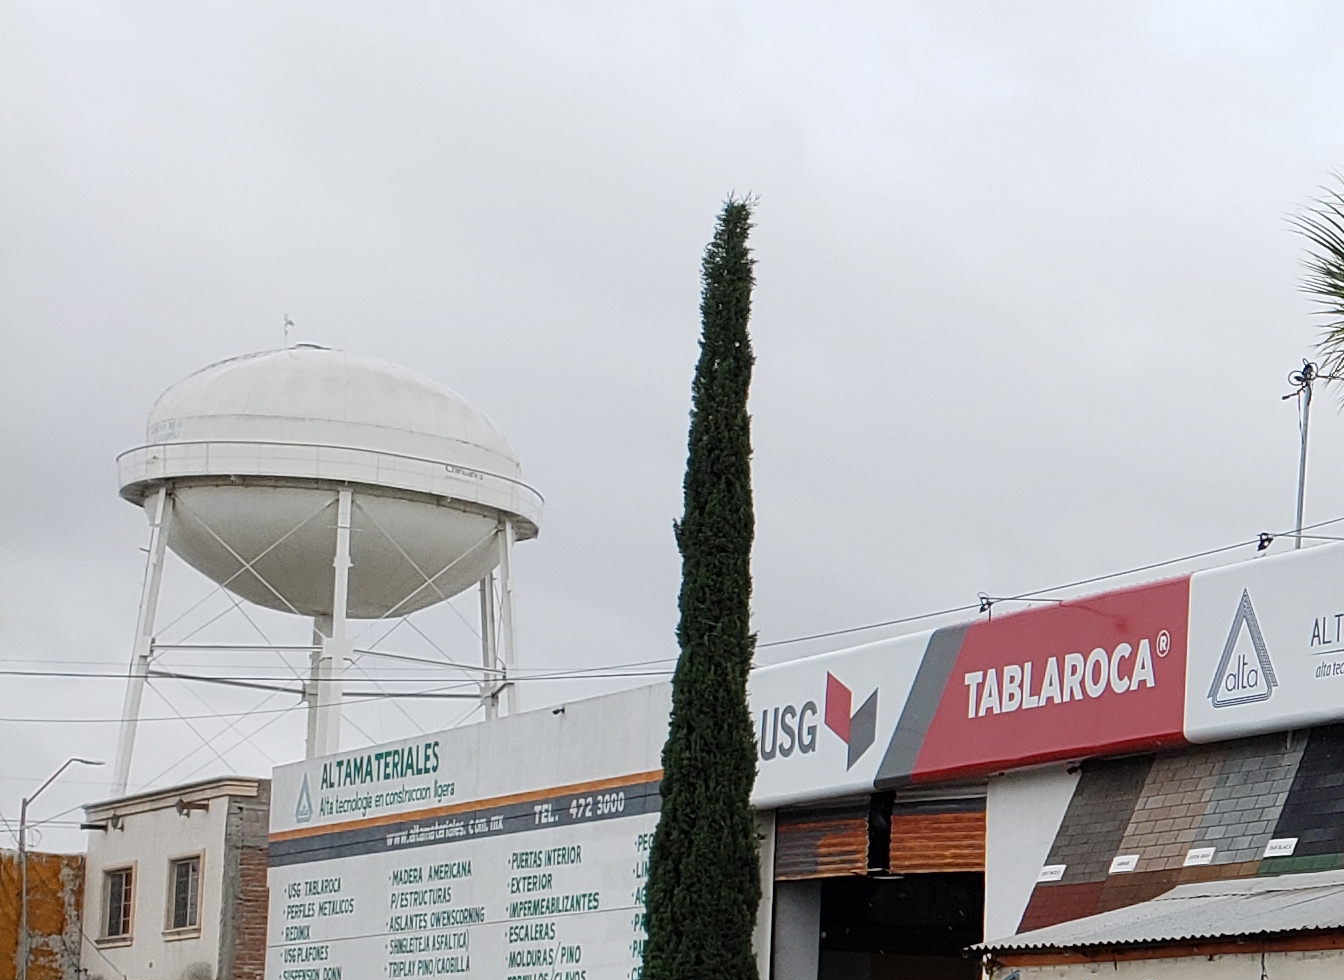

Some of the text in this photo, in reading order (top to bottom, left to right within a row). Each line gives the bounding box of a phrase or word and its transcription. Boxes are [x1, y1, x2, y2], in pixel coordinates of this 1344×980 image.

[964, 638, 1156, 719] TABLAROCA
[1225, 654, 1260, 692] alta
[1315, 661, 1331, 678] alta
[760, 700, 819, 761] USG
[320, 740, 440, 790] ALTAMATERIALES
[319, 797, 334, 818] Alta
[374, 794, 385, 808] en
[433, 778, 455, 803] ligera
[533, 791, 626, 826] TEL. 472 3000
[512, 845, 581, 870] PUERTAS INTERIOR
[392, 860, 472, 886] MADERA AMERICANA
[510, 873, 552, 894] EXTERIOR
[286, 898, 354, 920] PERFILES METALICOS
[390, 887, 451, 909] P/ESTRUCTURAS
[509, 892, 599, 918] IMPERMEABILIZANTES
[388, 913, 427, 932] AISLANTES
[509, 923, 555, 943] ESCALERAS
[388, 960, 416, 978] TRIPLAY
